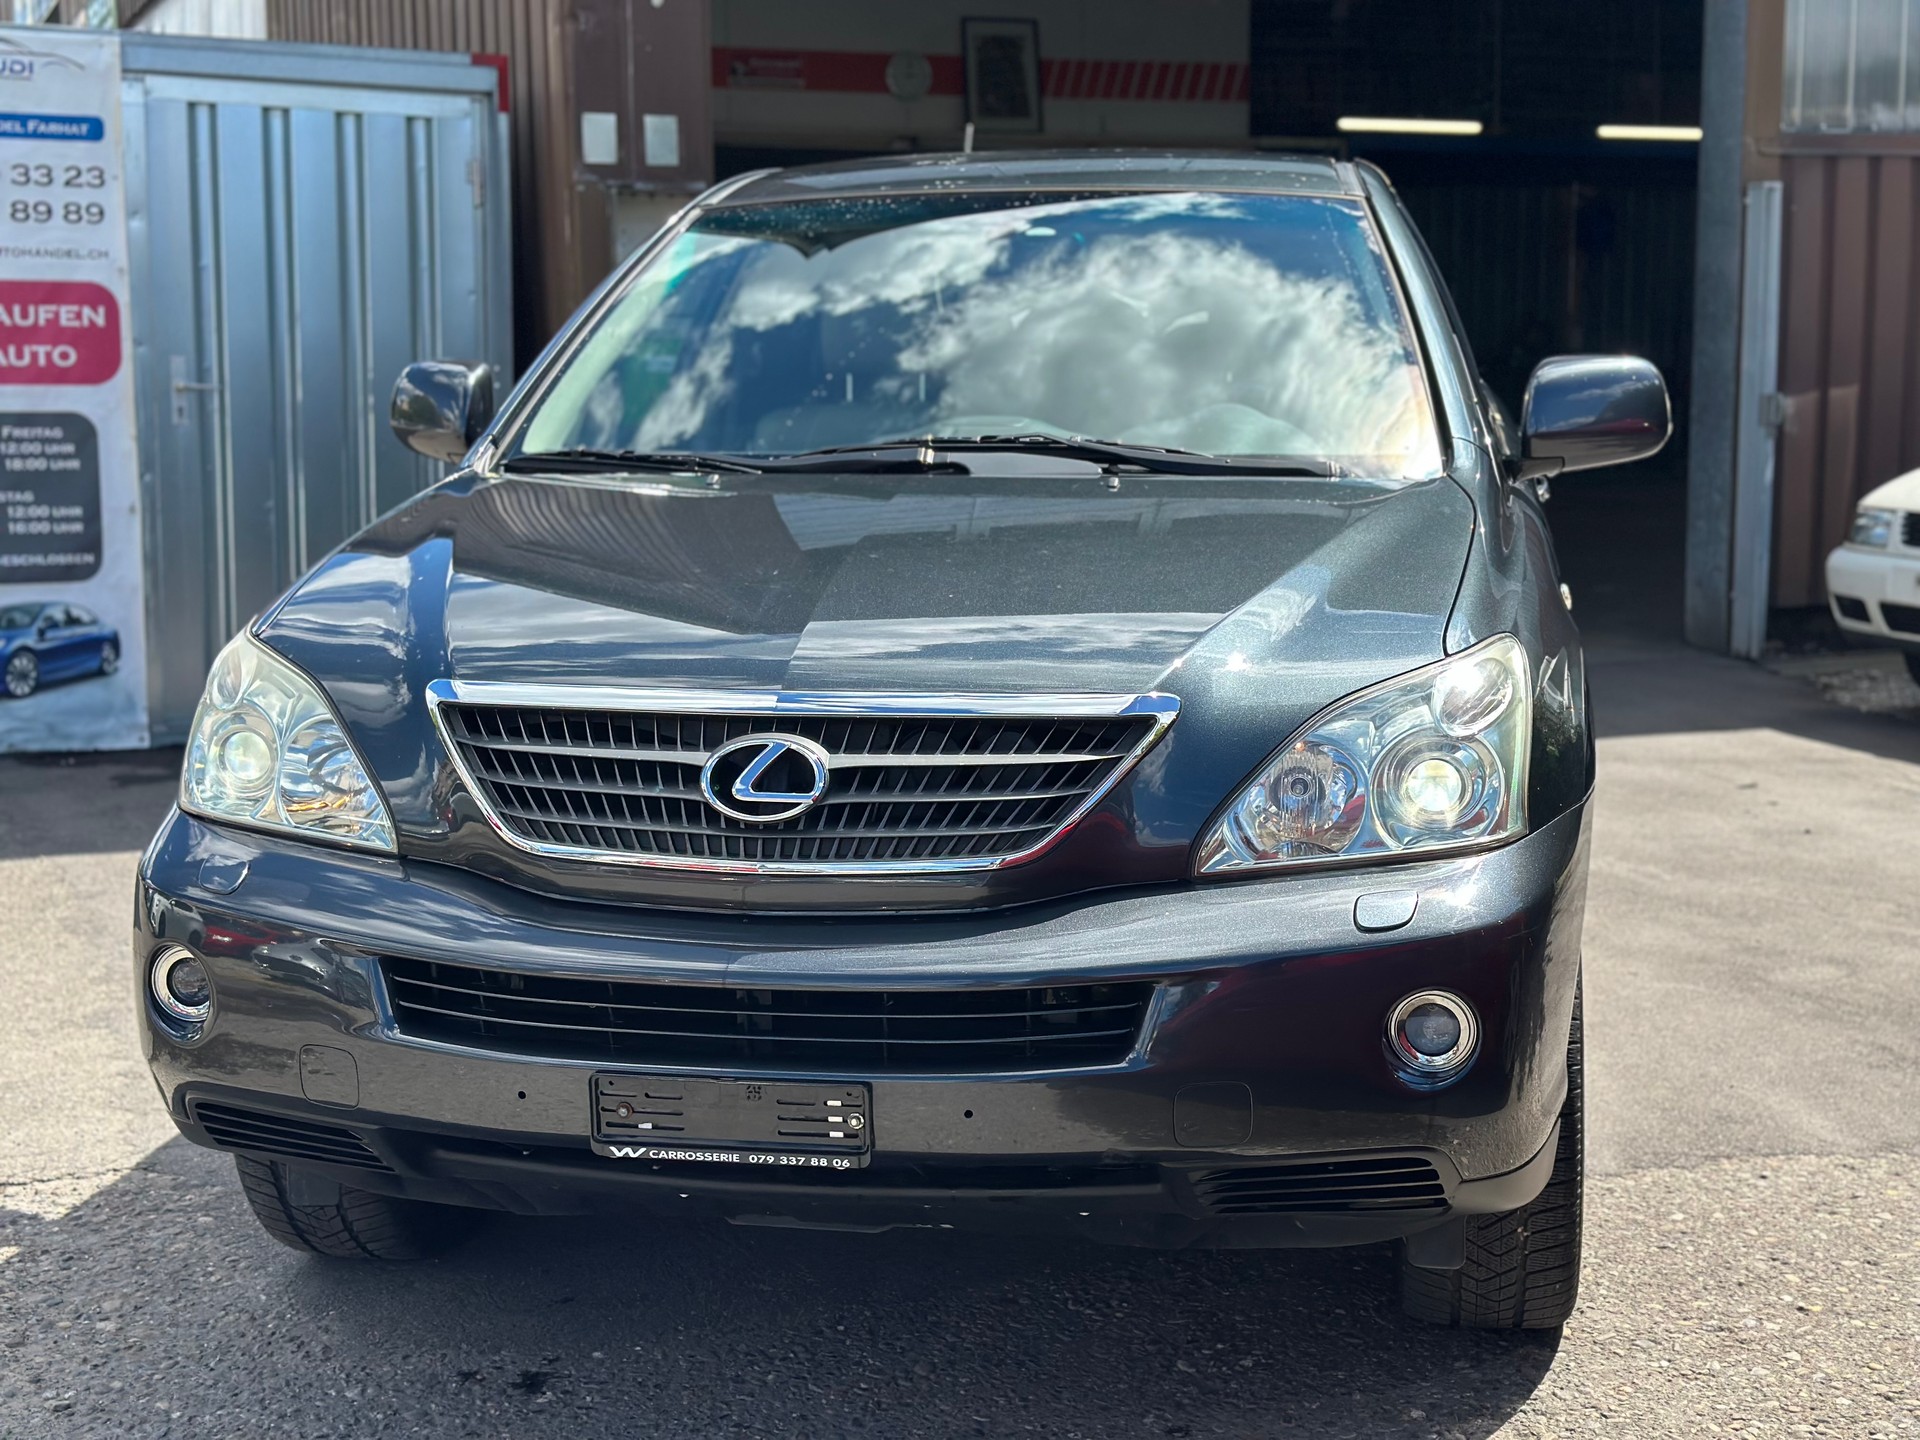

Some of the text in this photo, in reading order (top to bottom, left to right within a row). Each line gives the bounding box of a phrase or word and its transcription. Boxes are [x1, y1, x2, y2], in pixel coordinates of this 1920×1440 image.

[10, 163, 106, 189] 33 23
[10, 199, 105, 225] 89 89
[649, 1150, 740, 1162] CARROSSERIE
[748, 1154, 775, 1164] 079
[779, 1156, 806, 1166] 337
[810, 1157, 828, 1167] 88
[832, 1158, 850, 1168] 06
